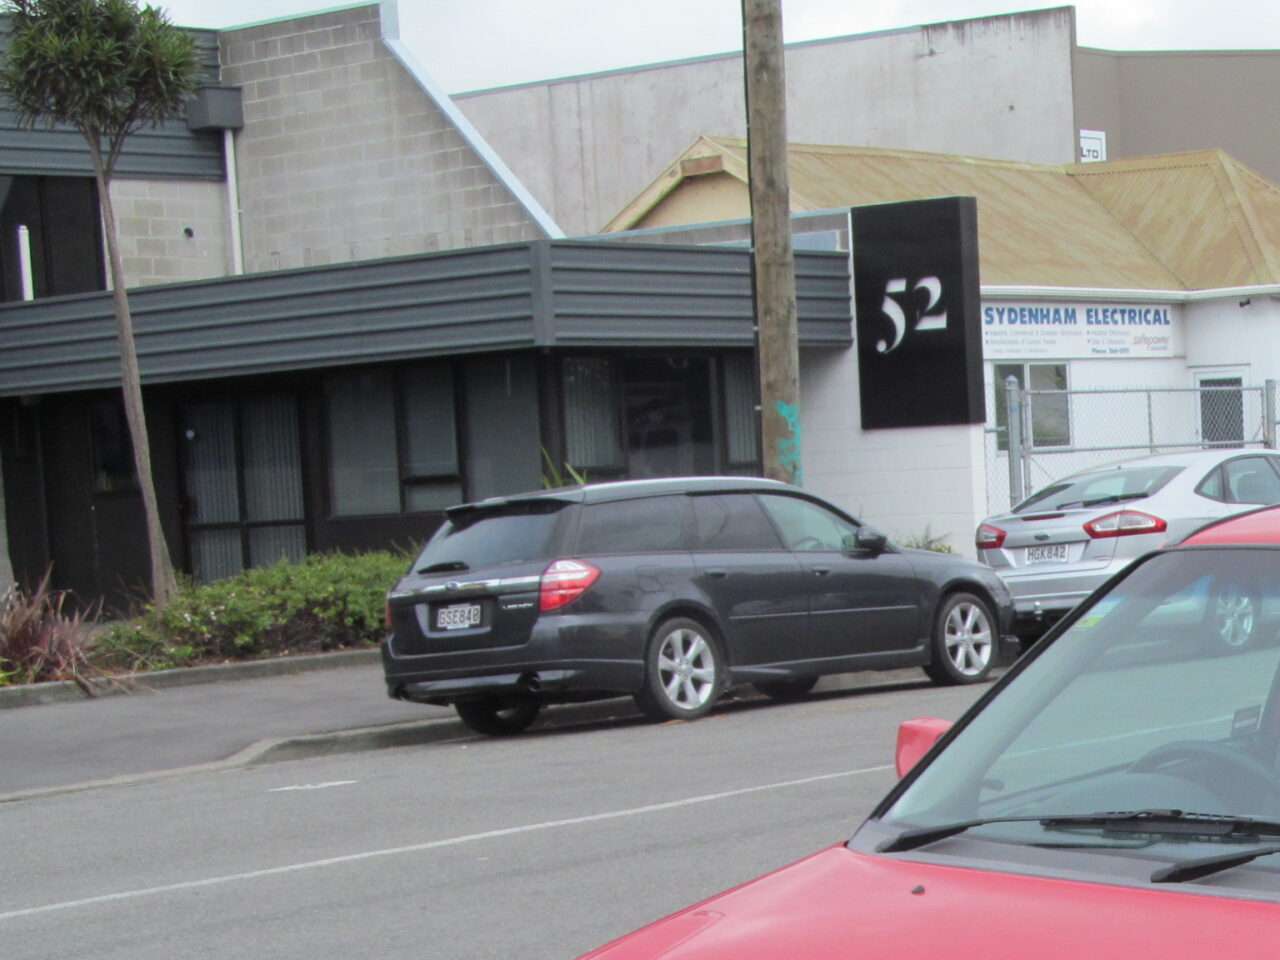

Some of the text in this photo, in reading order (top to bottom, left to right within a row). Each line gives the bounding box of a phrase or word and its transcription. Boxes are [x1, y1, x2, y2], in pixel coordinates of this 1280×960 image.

[876, 276, 947, 354] 52
[984, 306, 1170, 326] SYDENHAM ELECTRICAL
